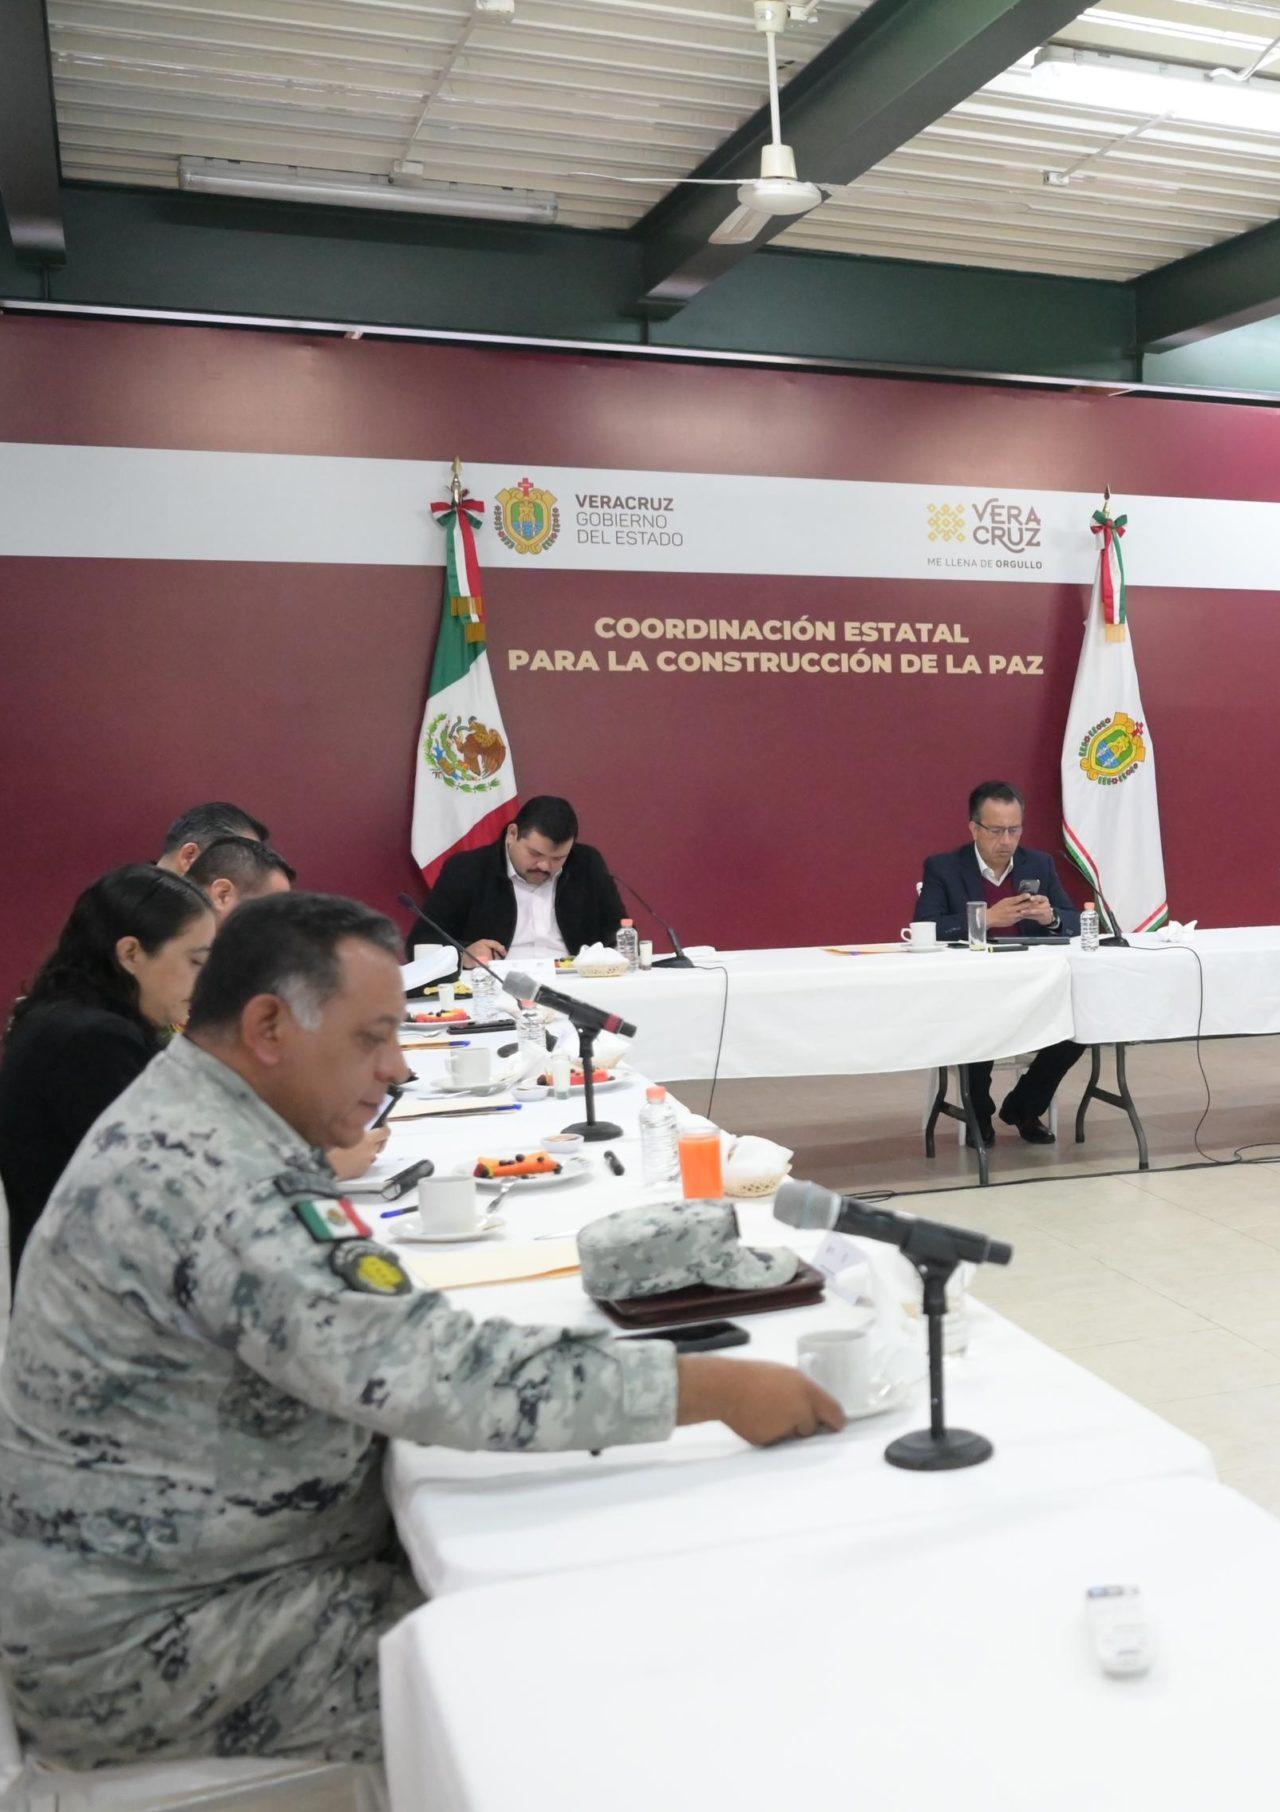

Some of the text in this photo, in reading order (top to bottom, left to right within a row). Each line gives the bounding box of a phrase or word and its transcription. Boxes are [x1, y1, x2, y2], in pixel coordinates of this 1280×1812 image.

[575, 494, 674, 511] VERACRUZ
[972, 498, 1041, 526] VERA
[576, 512, 667, 529] GOBIERNO
[577, 530, 684, 547] DEL ESTADO
[973, 526, 1041, 553] CRUZ
[927, 557, 1043, 569] ME LLENA DE ORGULLO
[594, 615, 969, 643] COORDINACIÓN ESTATAL
[508, 647, 1044, 675] PARA LA CONSTRUCCIÓN DE LA PAZ
